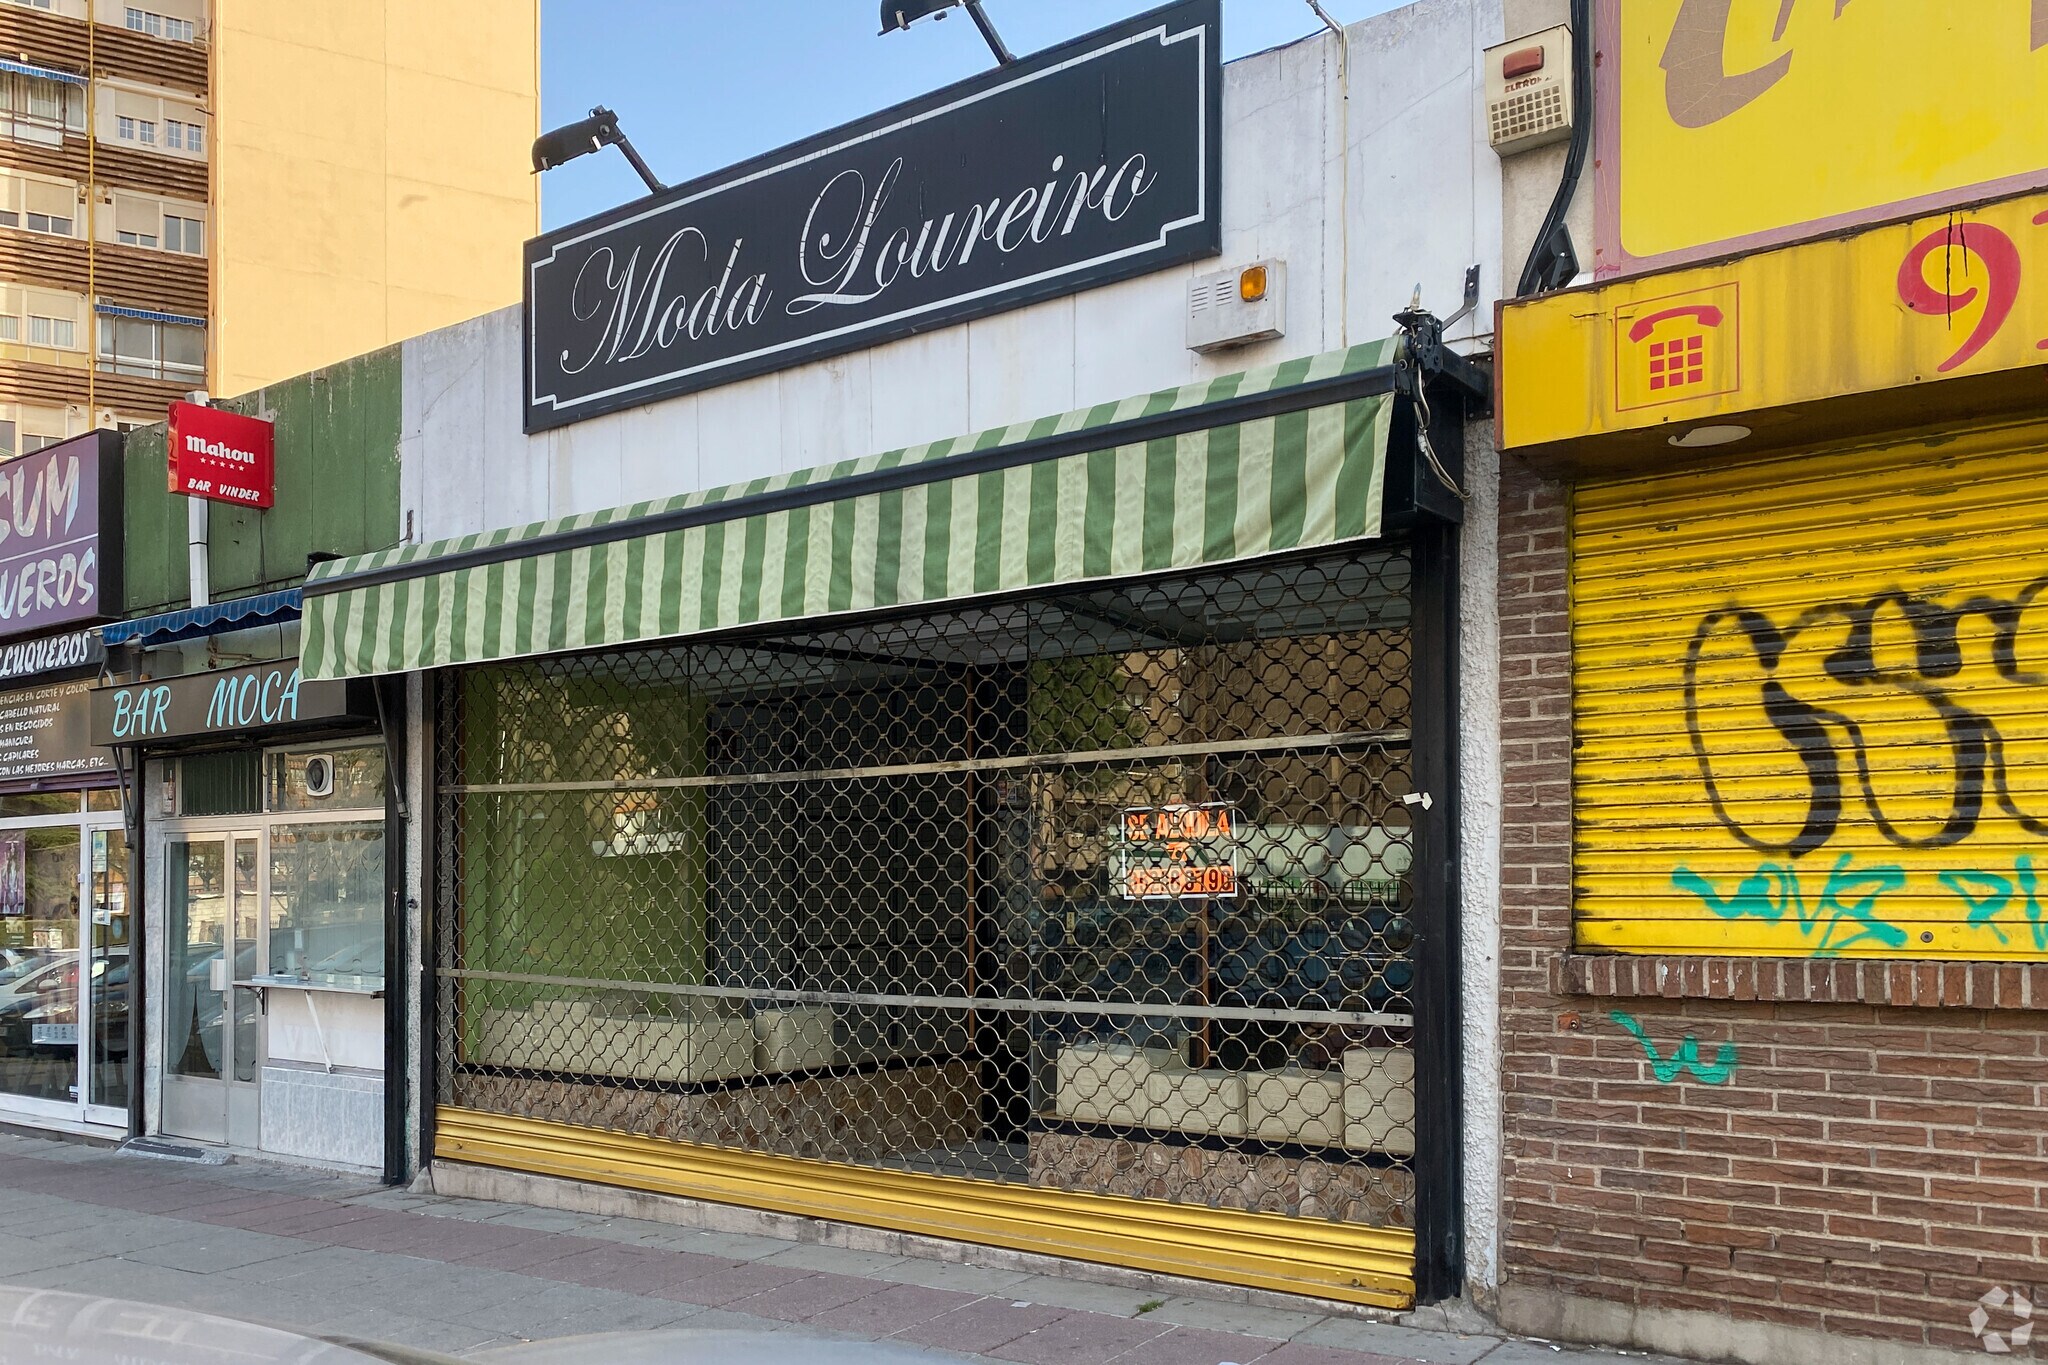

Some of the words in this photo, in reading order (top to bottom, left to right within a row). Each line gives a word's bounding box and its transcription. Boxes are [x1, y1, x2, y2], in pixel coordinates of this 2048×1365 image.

[559, 226, 773, 374] Moda
[786, 153, 1157, 316] Loureiro
[185, 434, 255, 465] Mahou
[187, 478, 211, 493] BAR
[219, 483, 260, 502] VINDER
[25, 692, 34, 702] EN
[36, 688, 58, 700] CORTE
[66, 683, 89, 695] COLOR
[0, 706, 29, 720] CABELLO
[29, 702, 60, 716] NATURAL
[112, 685, 171, 738] BAR
[206, 667, 299, 729] MOCA
[5, 723, 14, 733] EN
[15, 718, 54, 731] RECOGIDOS
[3, 749, 39, 762] CAPILARES
[12, 765, 24, 776] LAS
[25, 762, 55, 774] MEJORES
